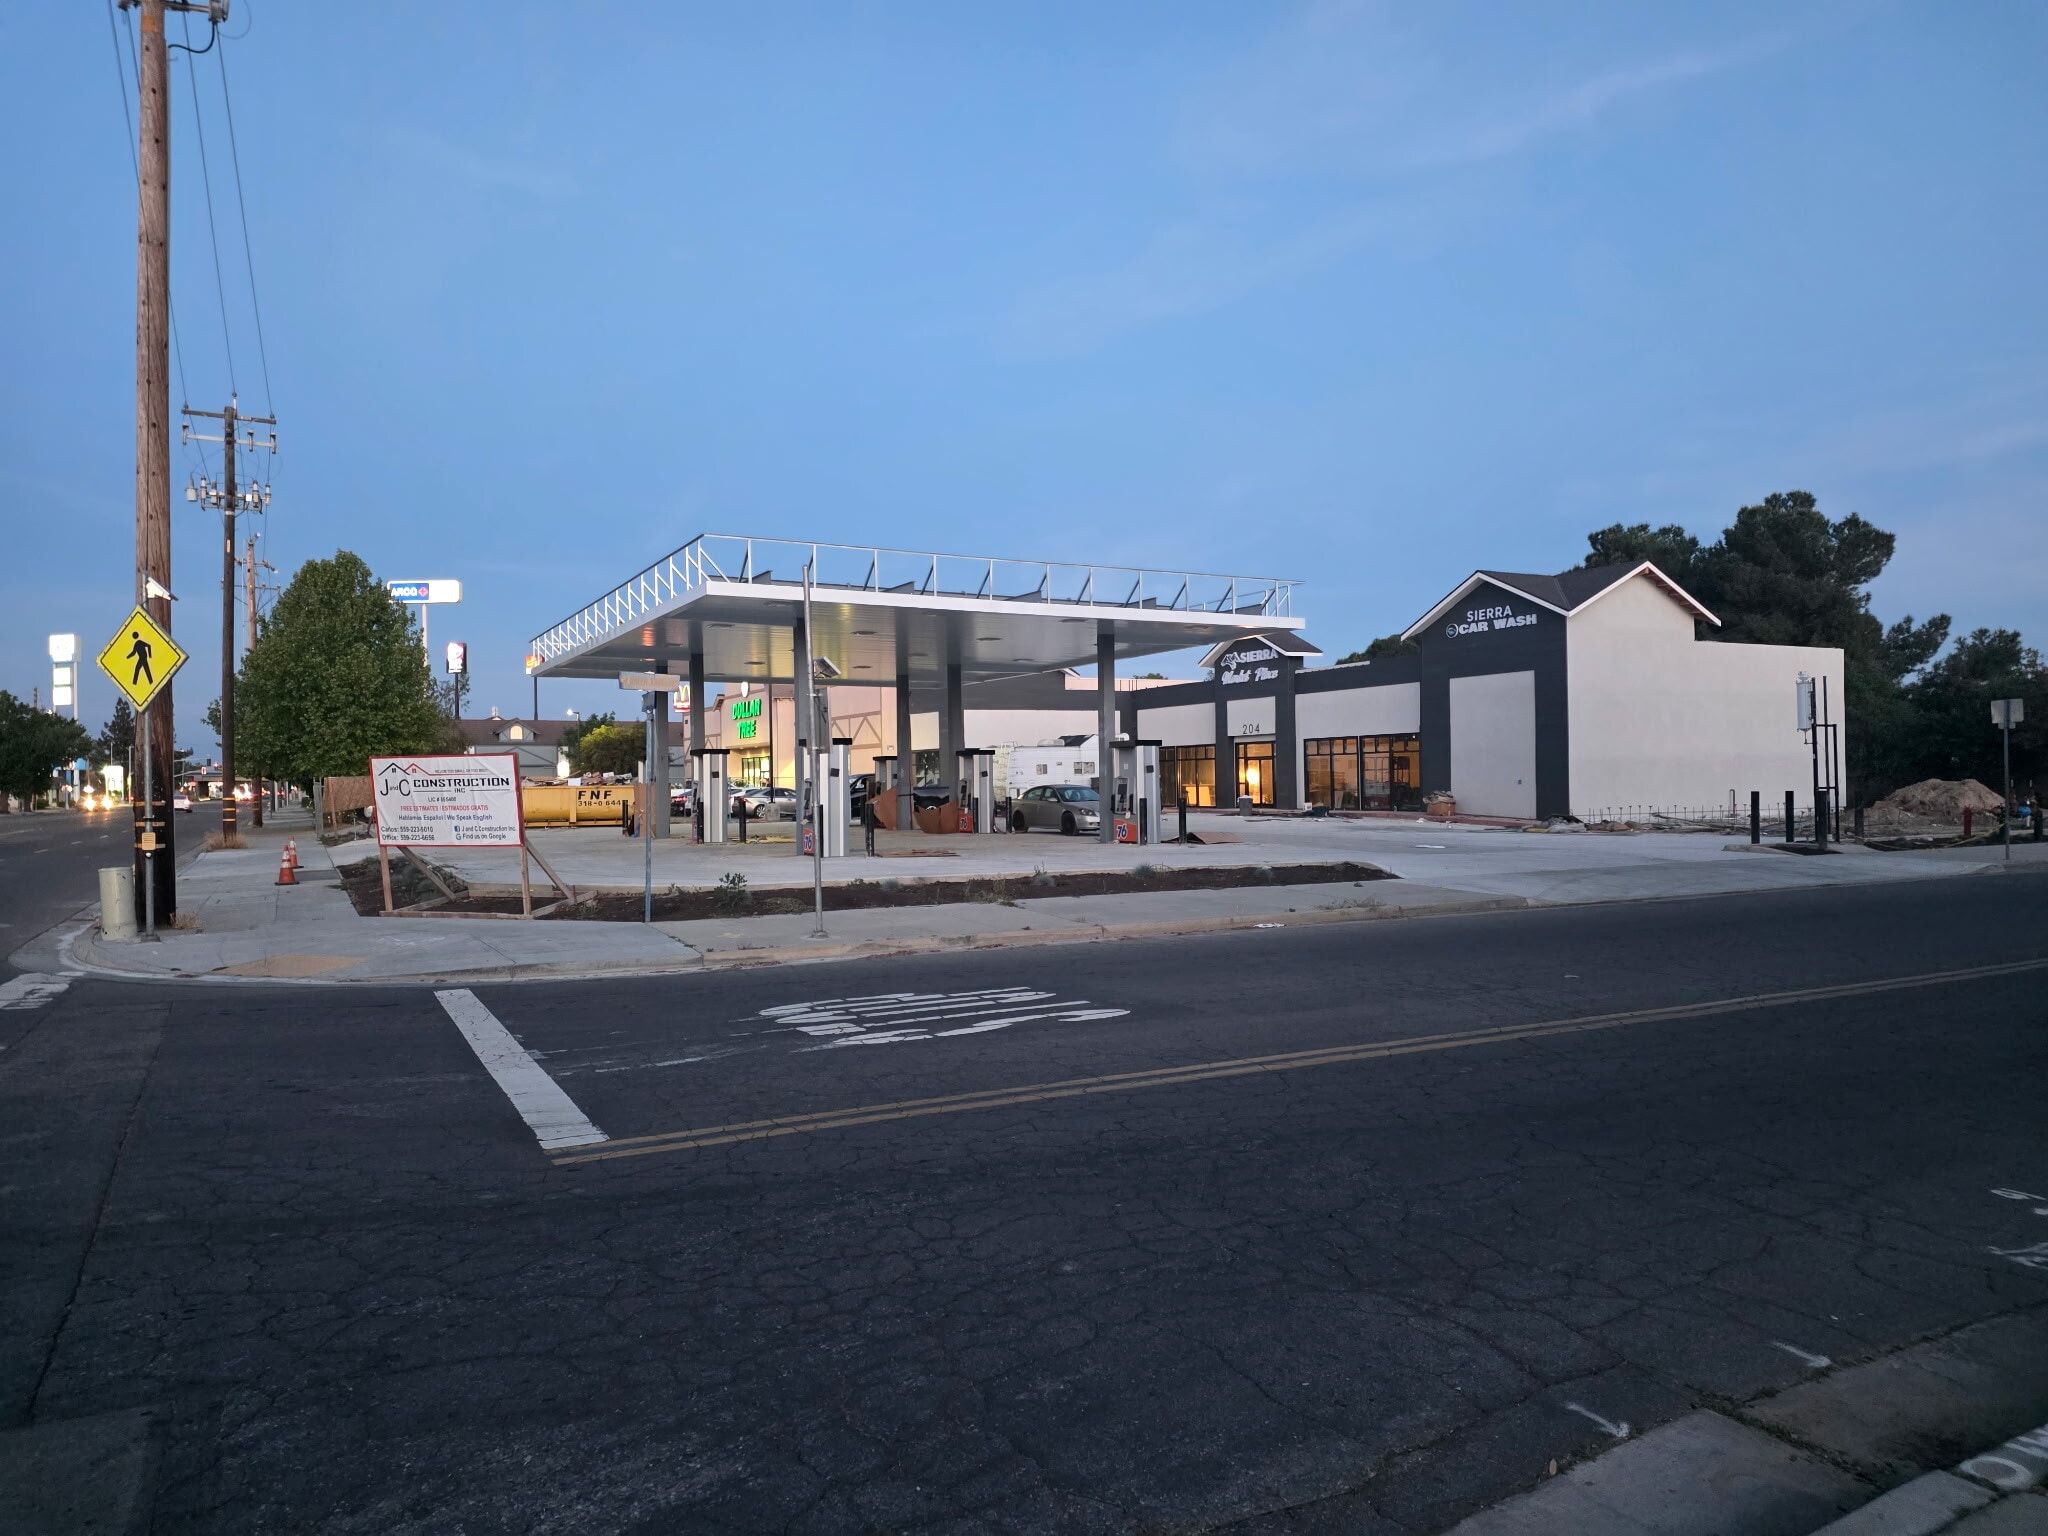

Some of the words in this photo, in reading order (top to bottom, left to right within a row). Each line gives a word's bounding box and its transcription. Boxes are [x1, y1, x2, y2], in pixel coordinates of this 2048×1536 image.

[1466, 605, 1512, 622] SIERRA
[1458, 621, 1489, 634] CAR
[1493, 613, 1538, 630] WASH
[1240, 648, 1279, 663] SIERRA
[732, 698, 761, 720] DOLLAR
[736, 720, 757, 739] TREE
[1242, 723, 1260, 735] 204
[380, 778, 389, 796] J
[398, 778, 411, 797] C
[413, 777, 510, 789] CONSTRUCTION
[456, 814, 472, 822] Speak
[472, 814, 493, 822] English
[462, 832, 473, 840] Find
[488, 832, 507, 841] Google
[1116, 823, 1128, 840] 76
